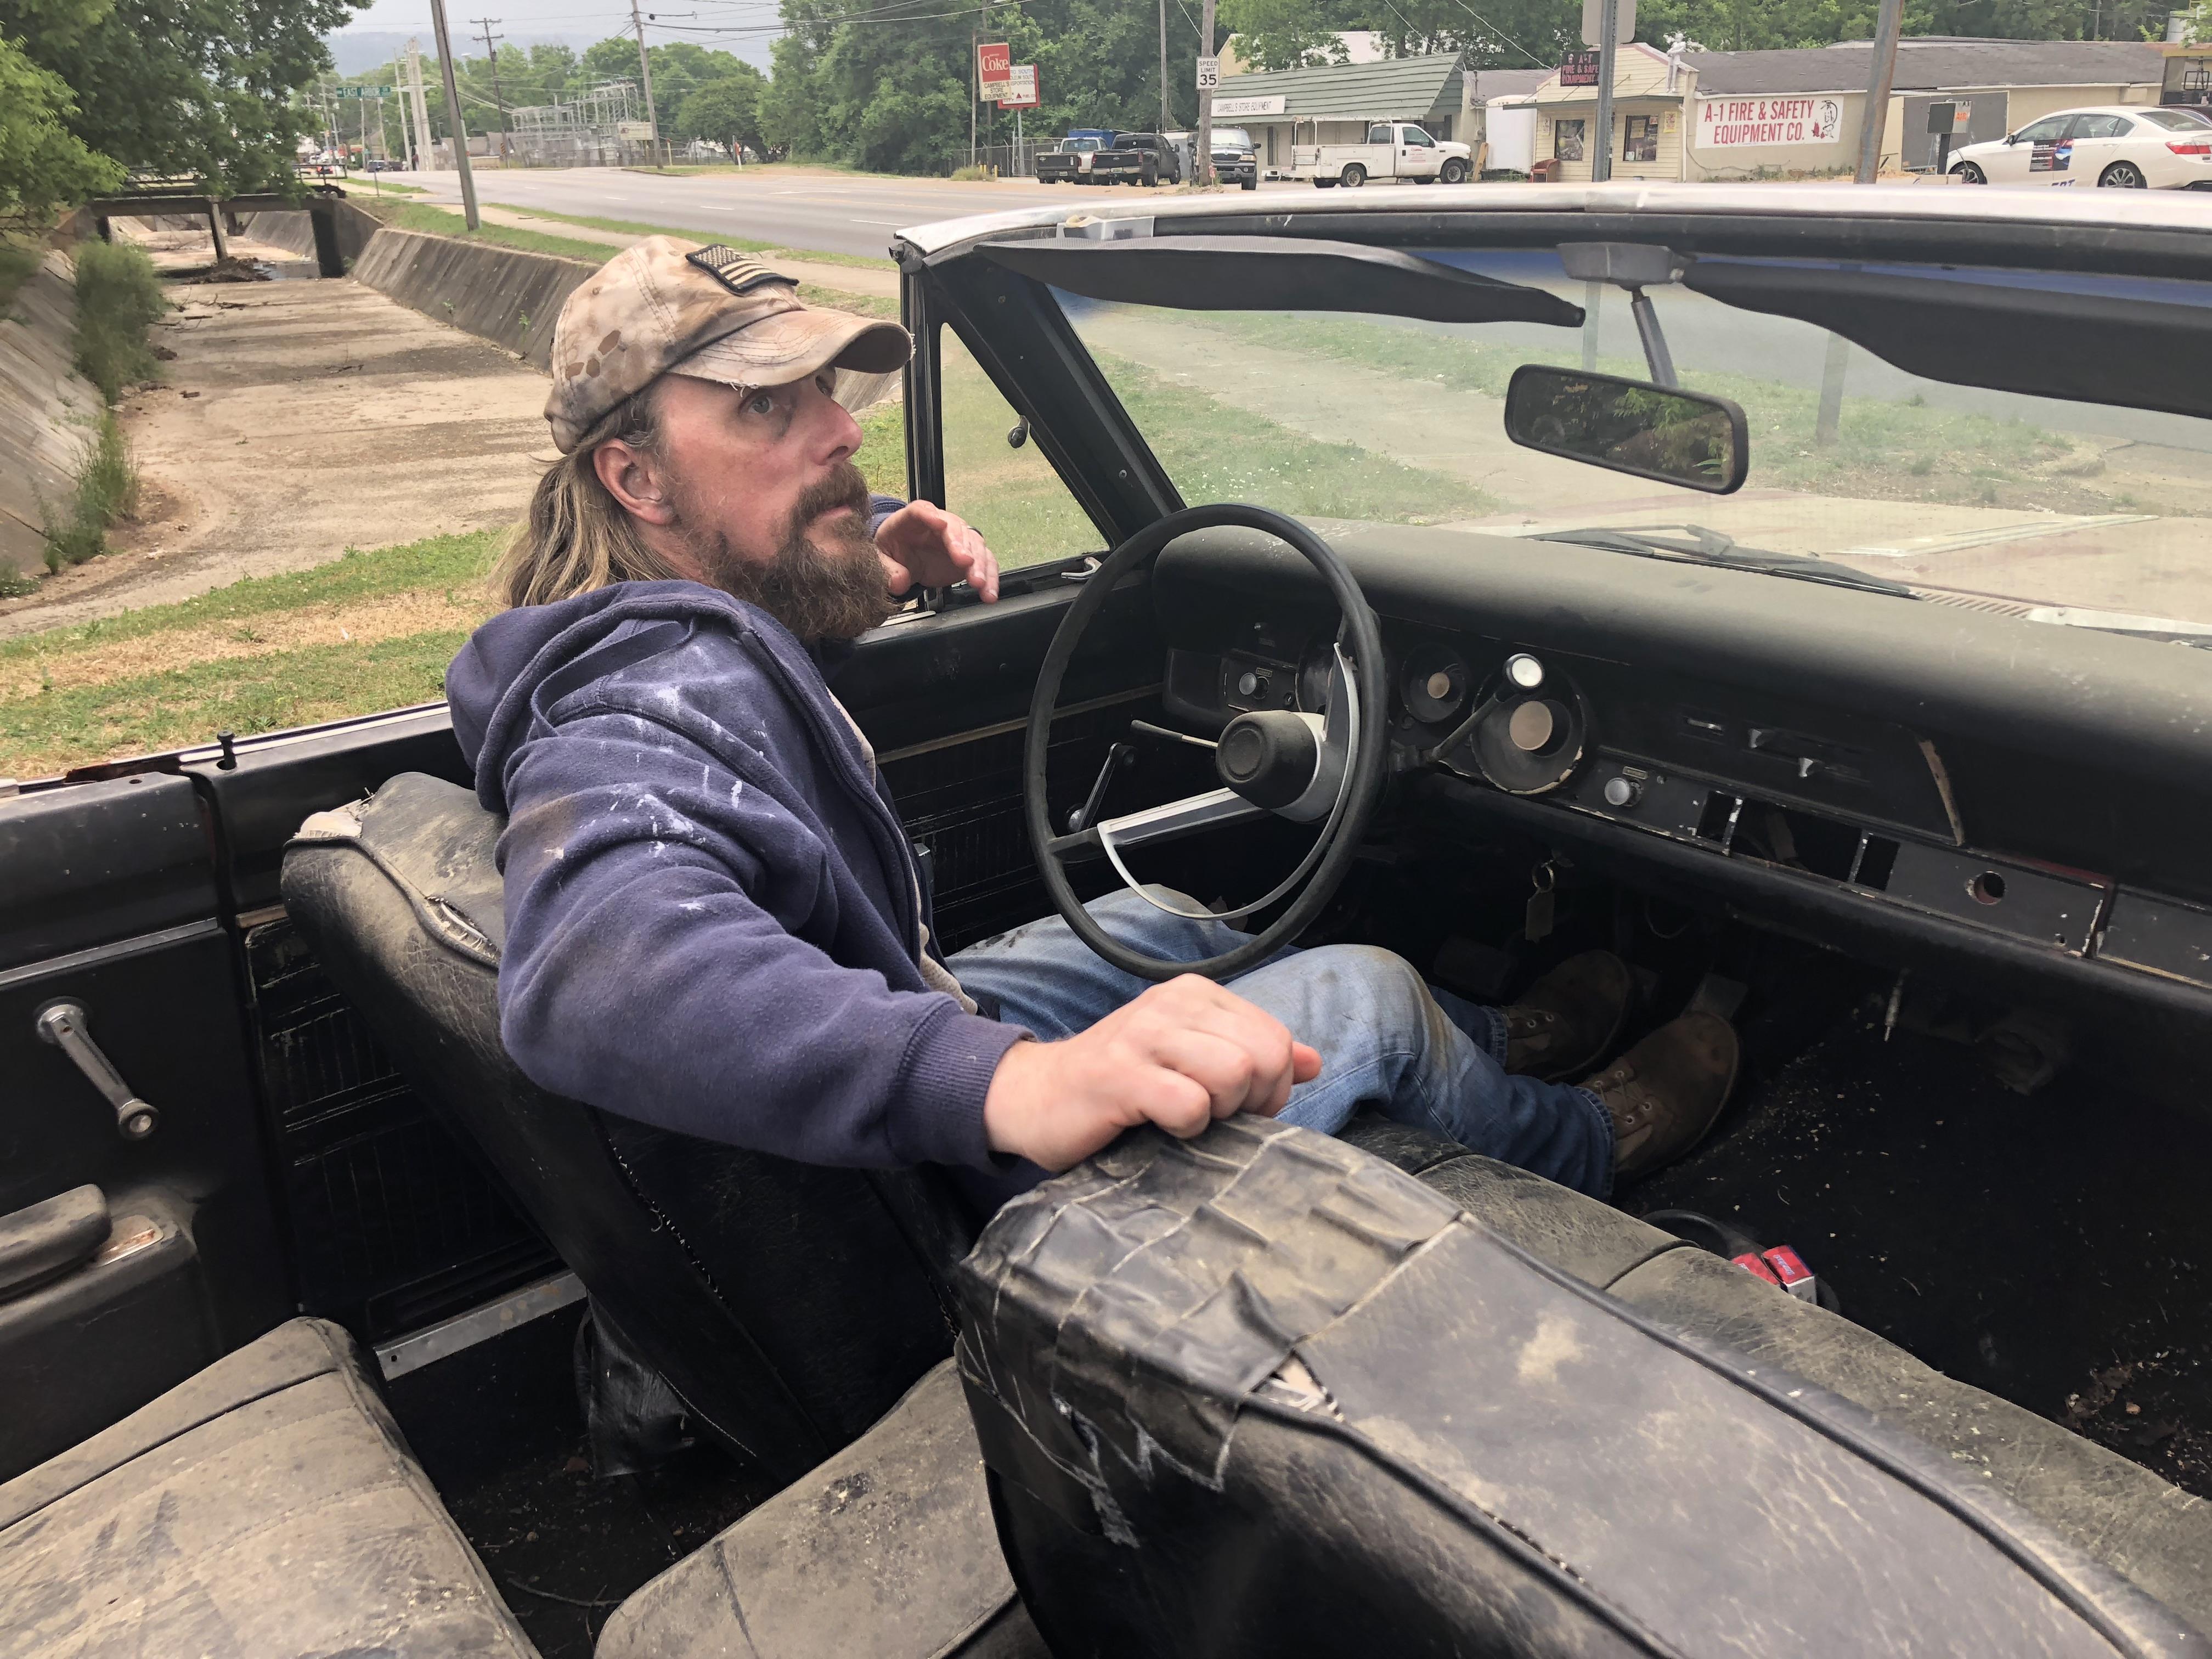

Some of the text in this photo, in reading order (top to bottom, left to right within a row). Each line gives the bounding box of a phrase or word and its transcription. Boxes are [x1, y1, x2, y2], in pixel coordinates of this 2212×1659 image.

[982, 56, 1009, 72] Coke
[1562, 65, 1575, 74] FIRE
[1584, 64, 1599, 74] SAFE
[1200, 74, 1217, 86] 35
[1251, 100, 1272, 111] EQUIPMENT
[1705, 100, 1815, 122] A-1 FIRE & SAFETY
[1713, 122, 1805, 144] EQUIPMENT CO.
